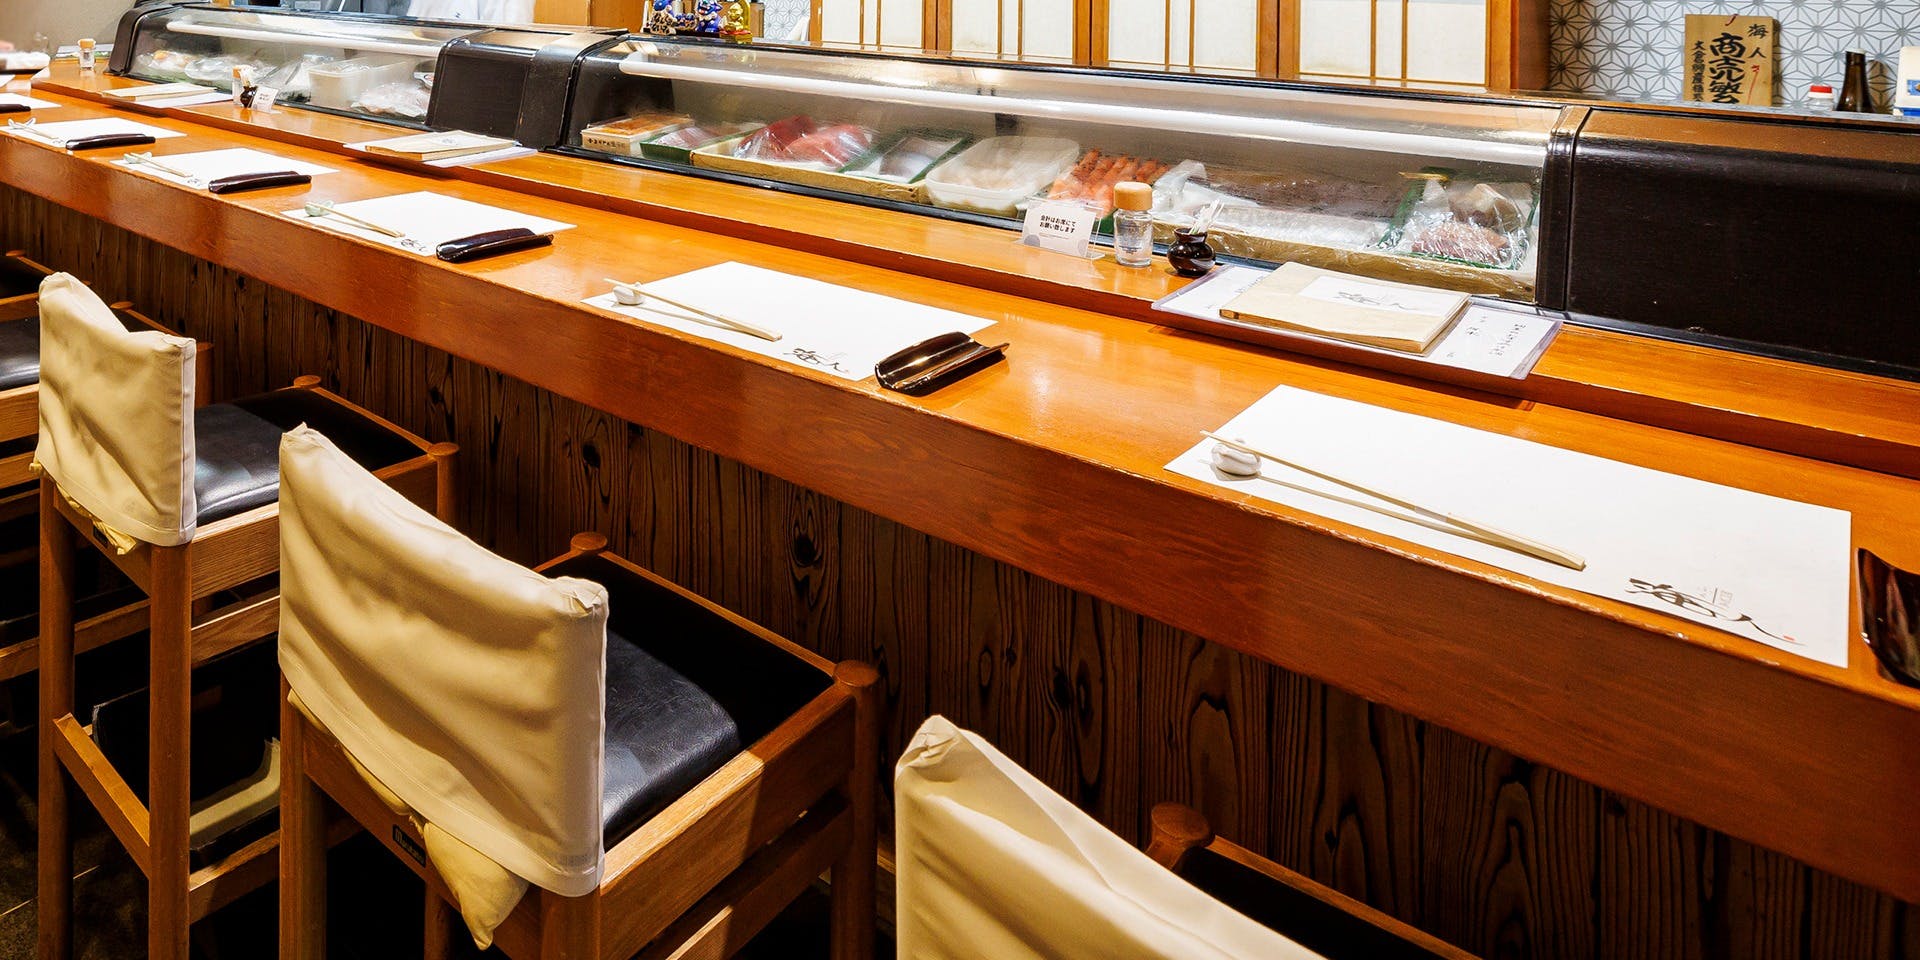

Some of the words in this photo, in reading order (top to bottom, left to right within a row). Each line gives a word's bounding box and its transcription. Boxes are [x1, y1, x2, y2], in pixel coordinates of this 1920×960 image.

[1039, 221, 1076, 234] お願い致します
